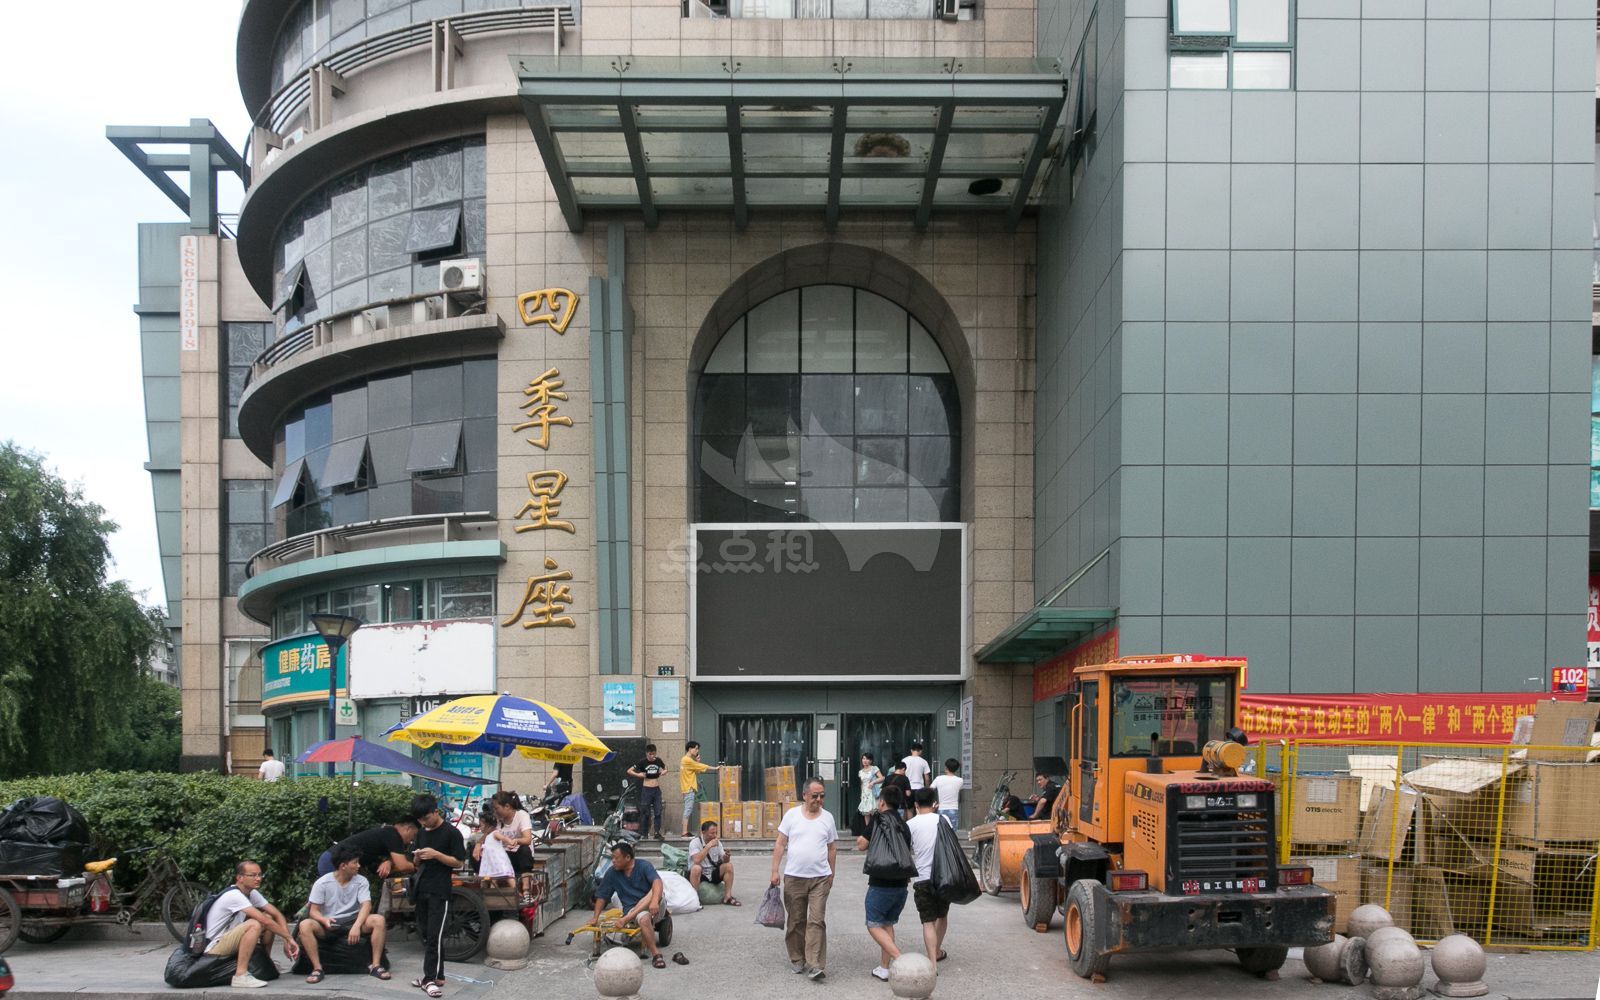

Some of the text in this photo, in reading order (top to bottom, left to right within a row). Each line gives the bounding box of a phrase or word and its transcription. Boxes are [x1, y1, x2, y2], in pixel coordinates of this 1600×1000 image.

[501, 286, 581, 630] 四季星座
[278, 642, 331, 675] 健康药房
[1560, 668, 1584, 684] 102
[1321, 806, 1344, 814] electric
